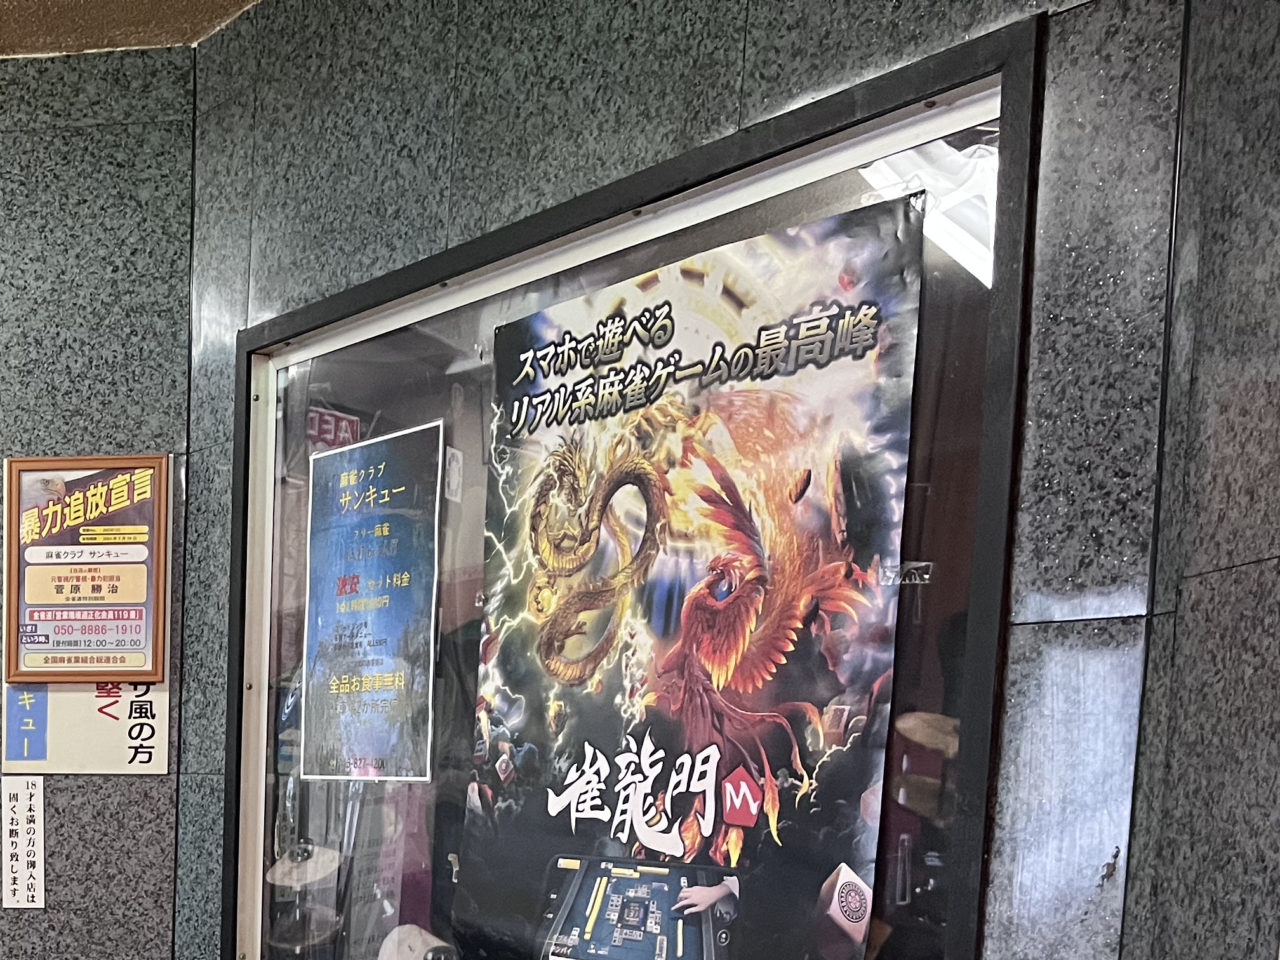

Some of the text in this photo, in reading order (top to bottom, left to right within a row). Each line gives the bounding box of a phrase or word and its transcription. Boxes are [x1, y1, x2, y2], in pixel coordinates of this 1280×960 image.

[510, 303, 883, 439] リアル系麻雀ゲームの最高峰
[511, 304, 674, 387] スマホで遊べる
[21, 468, 154, 544] 暴力追放宣言
[339, 485, 406, 514] サンキュー
[45, 550, 129, 559] 麻雀クラブ サンキュー
[54, 625, 141, 635] 050-8886-1910
[546, 726, 721, 858] 雀龍門
